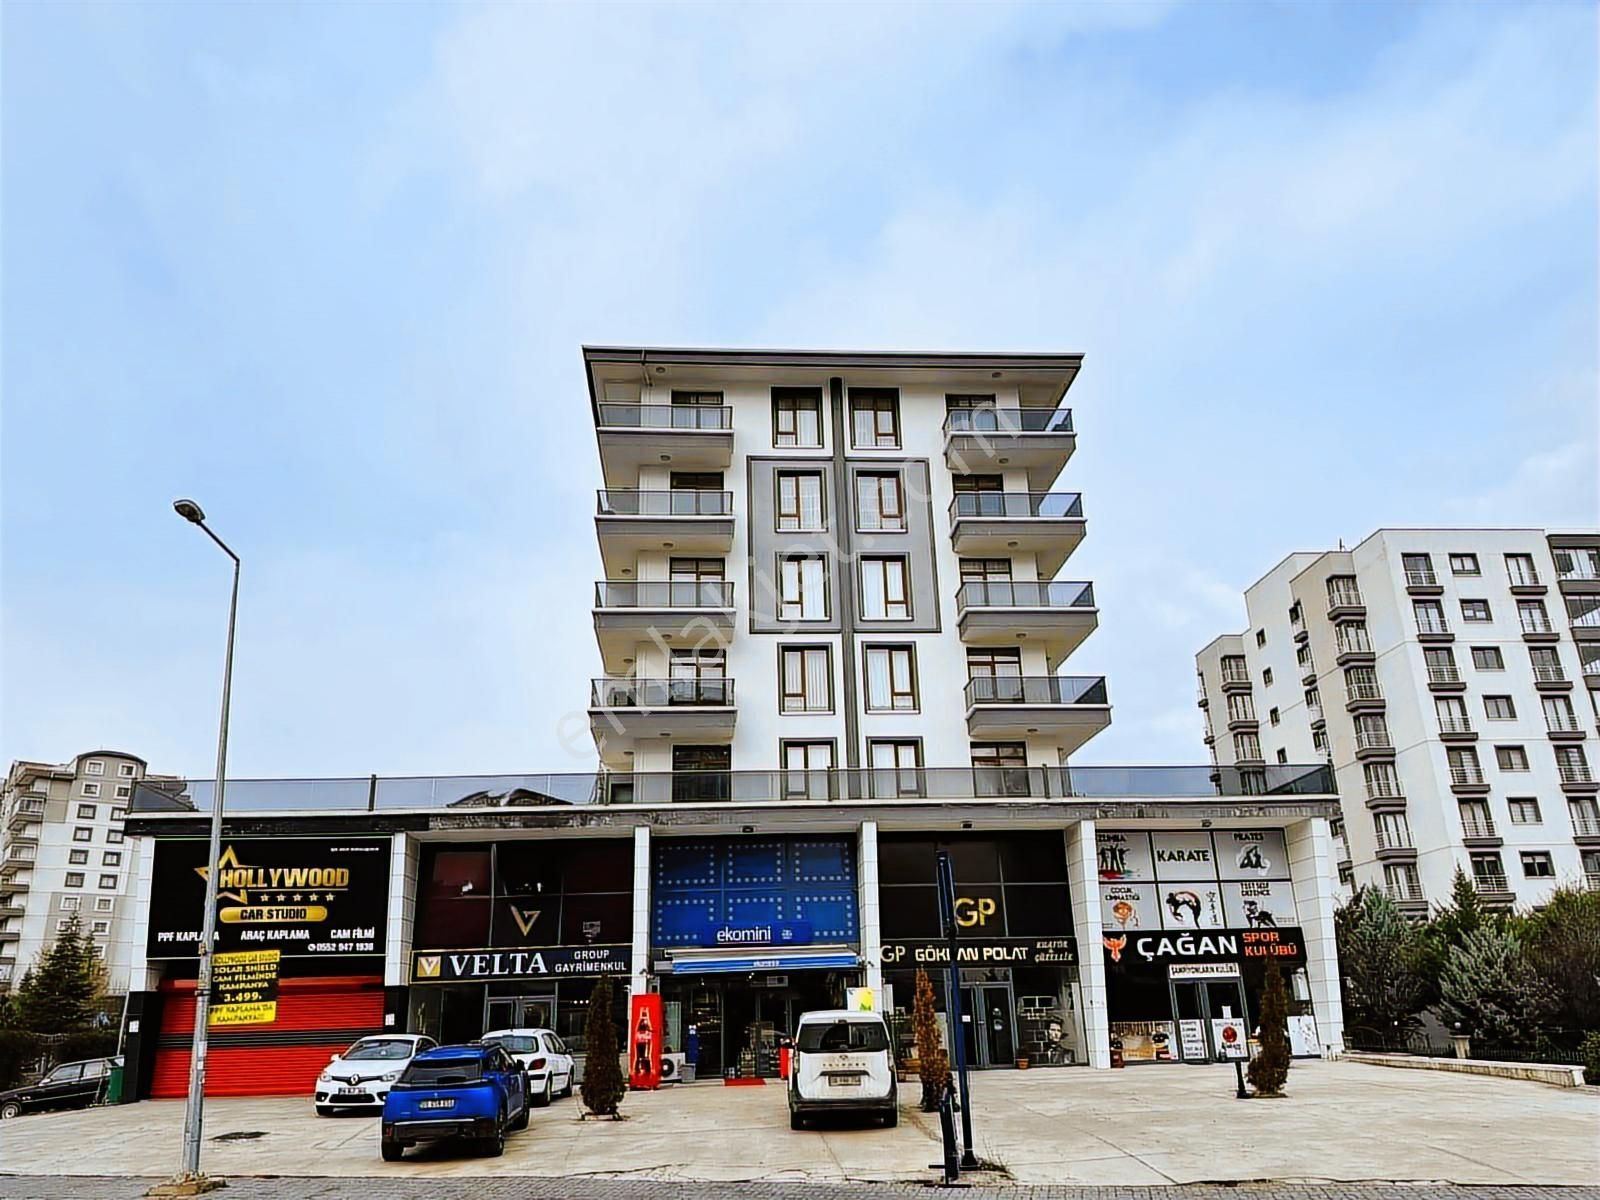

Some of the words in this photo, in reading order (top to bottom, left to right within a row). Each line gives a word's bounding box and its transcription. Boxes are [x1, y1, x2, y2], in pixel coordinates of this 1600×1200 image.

[1157, 850, 1210, 862] KARATE
[219, 867, 349, 889] HOLLYWOOD
[240, 909, 264, 920] CAR
[266, 908, 307, 920] STUDIO
[955, 897, 996, 927] GP
[158, 932, 174, 942] PPF
[176, 931, 220, 942] KAPLA
[240, 931, 265, 942] ARAÇ
[266, 930, 310, 940] KAPLAMA
[330, 929, 351, 939] CAM
[352, 926, 375, 939] FİLMİ
[716, 926, 771, 943] ekomini
[1242, 932, 1280, 942] SPOR
[1136, 932, 1239, 962] ÇAĞAN
[574, 950, 610, 960] GROUP
[880, 945, 906, 963] GP
[915, 945, 979, 962] GÖKAN
[983, 947, 1029, 961] POLAT
[449, 952, 548, 976] VELTA
[555, 960, 627, 973] GAYRİMENKUL
[213, 975, 232, 983] CAM
[234, 972, 277, 982] FİLMİNDE
[219, 982, 269, 990] KAMPANYA
